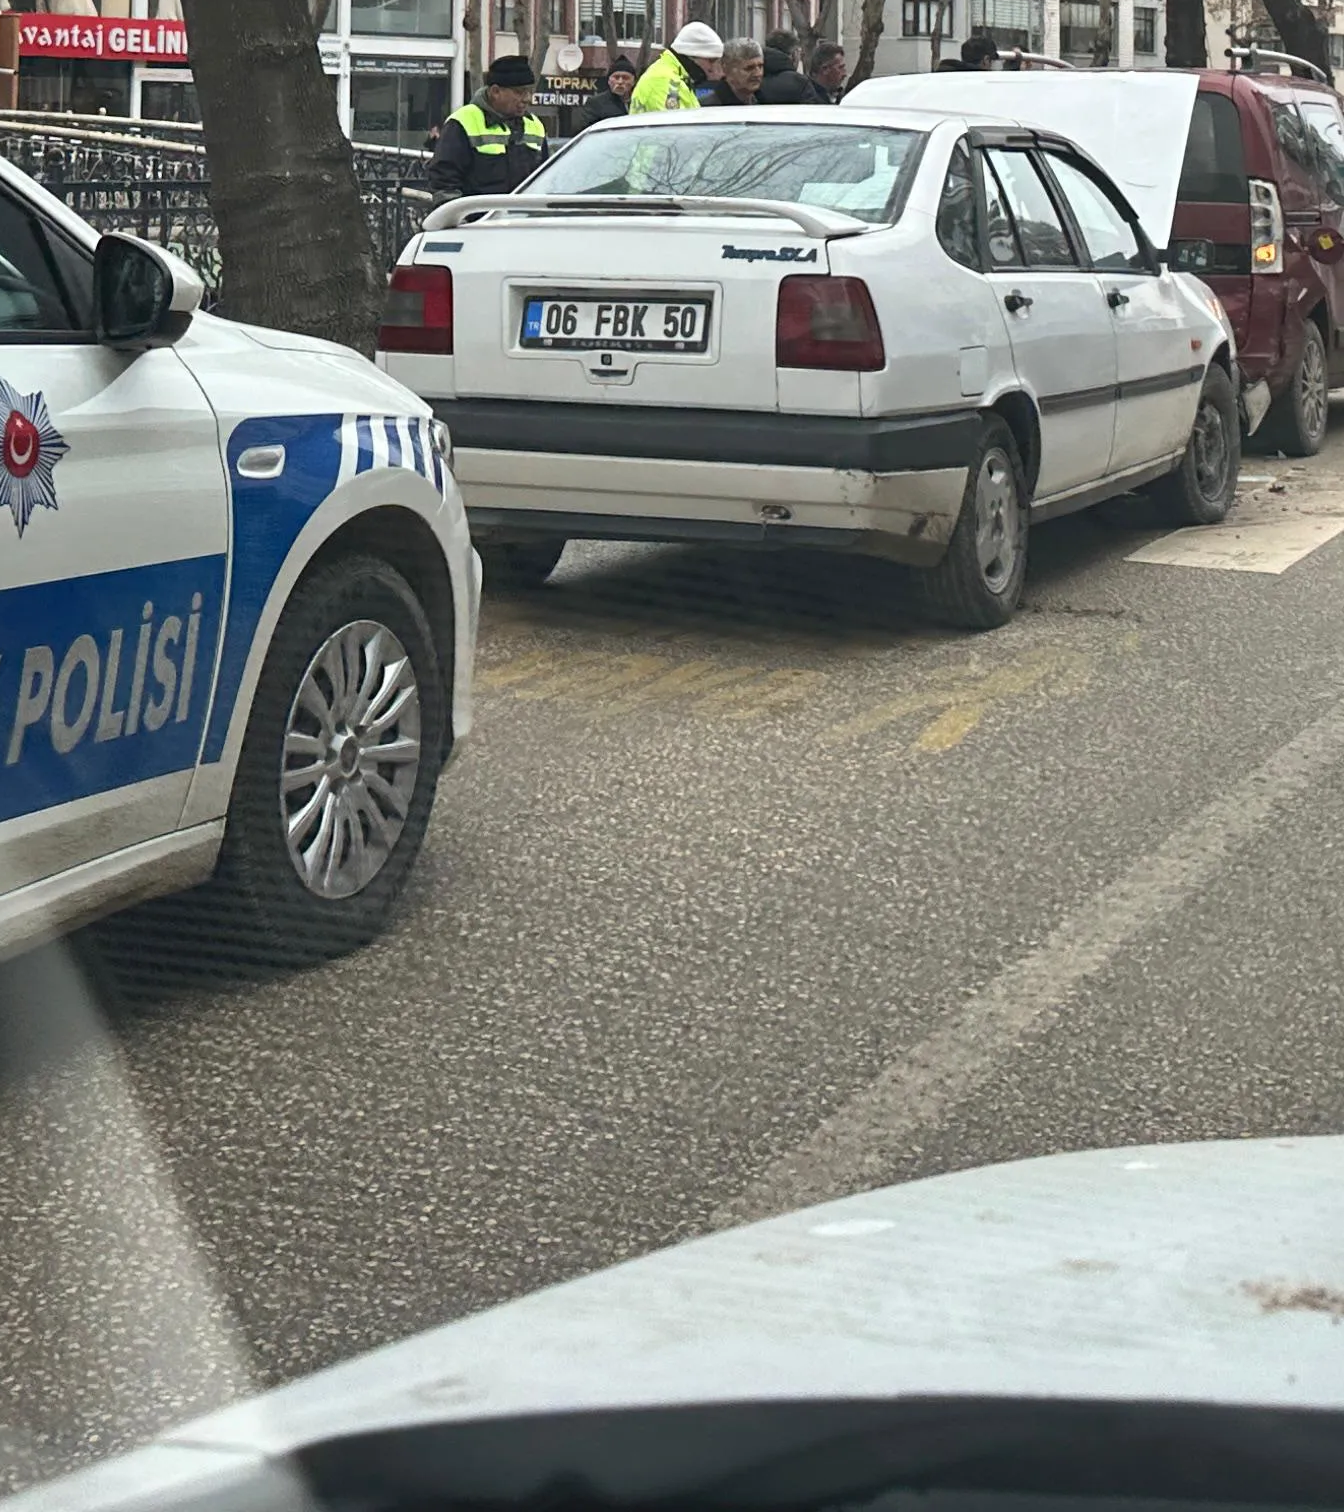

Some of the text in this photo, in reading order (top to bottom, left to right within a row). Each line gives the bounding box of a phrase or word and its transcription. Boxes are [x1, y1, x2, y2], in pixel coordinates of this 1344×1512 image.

[545, 76, 598, 90] TOPRAK
[531, 90, 580, 106] ETERİNER
[528, 303, 697, 339] TR 06 FBK 50
[6, 591, 202, 765] POLİSİ
